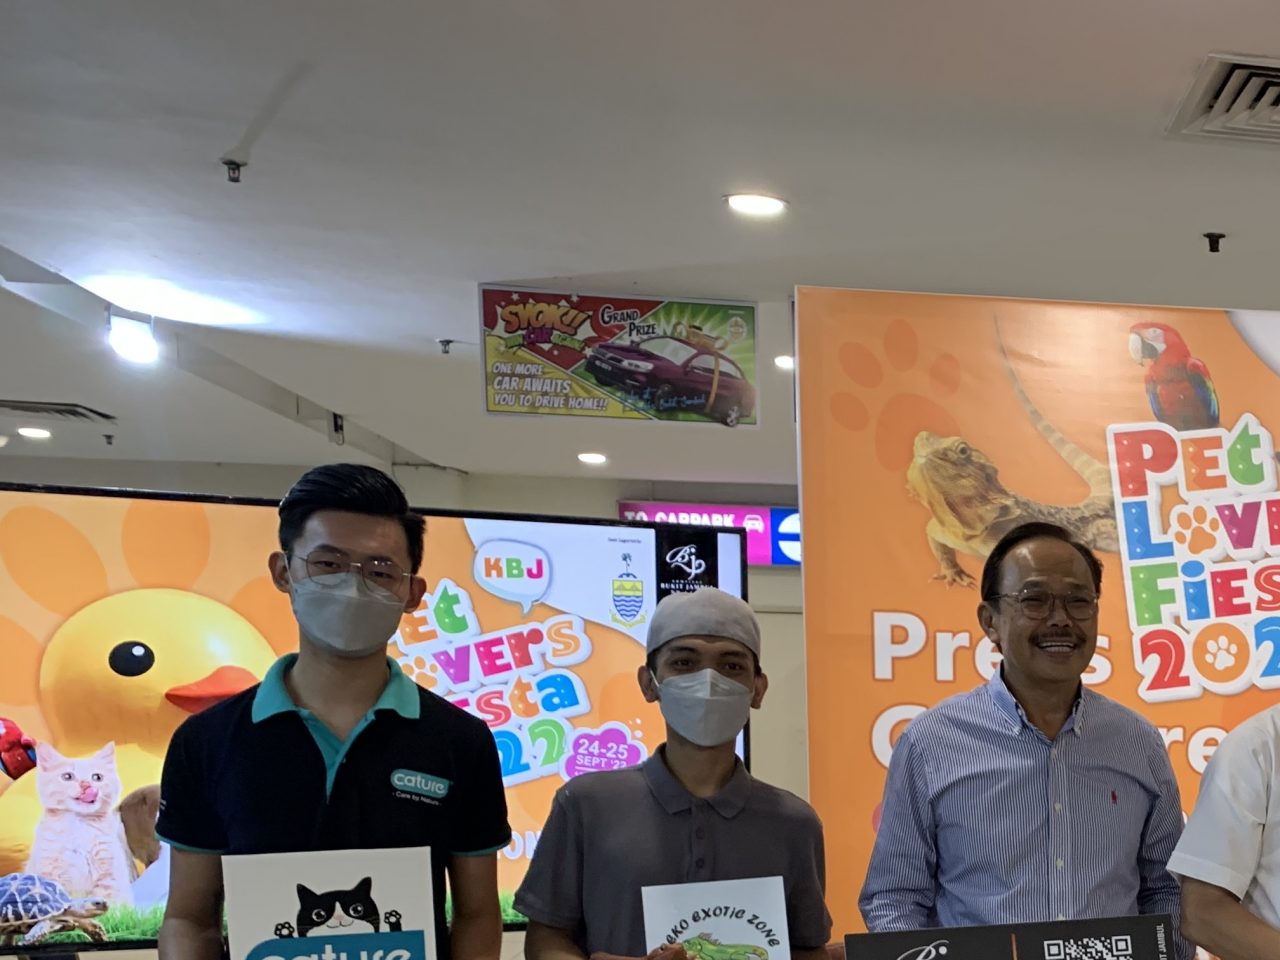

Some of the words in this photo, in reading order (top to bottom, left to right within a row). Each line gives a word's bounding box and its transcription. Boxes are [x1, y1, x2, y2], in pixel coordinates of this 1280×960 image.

[493, 362, 512, 374] ONE
[515, 363, 543, 375] MORE
[494, 376, 518, 391] CAR
[522, 377, 571, 393] AWAITS
[494, 394, 515, 405] YOU
[519, 395, 533, 406] TO
[535, 396, 565, 408] DRIVE
[484, 557, 543, 579] KBJ
[578, 738, 629, 759] 24-25
[576, 755, 608, 768] SEPT
[1156, 923, 1167, 952] JAMBUL
